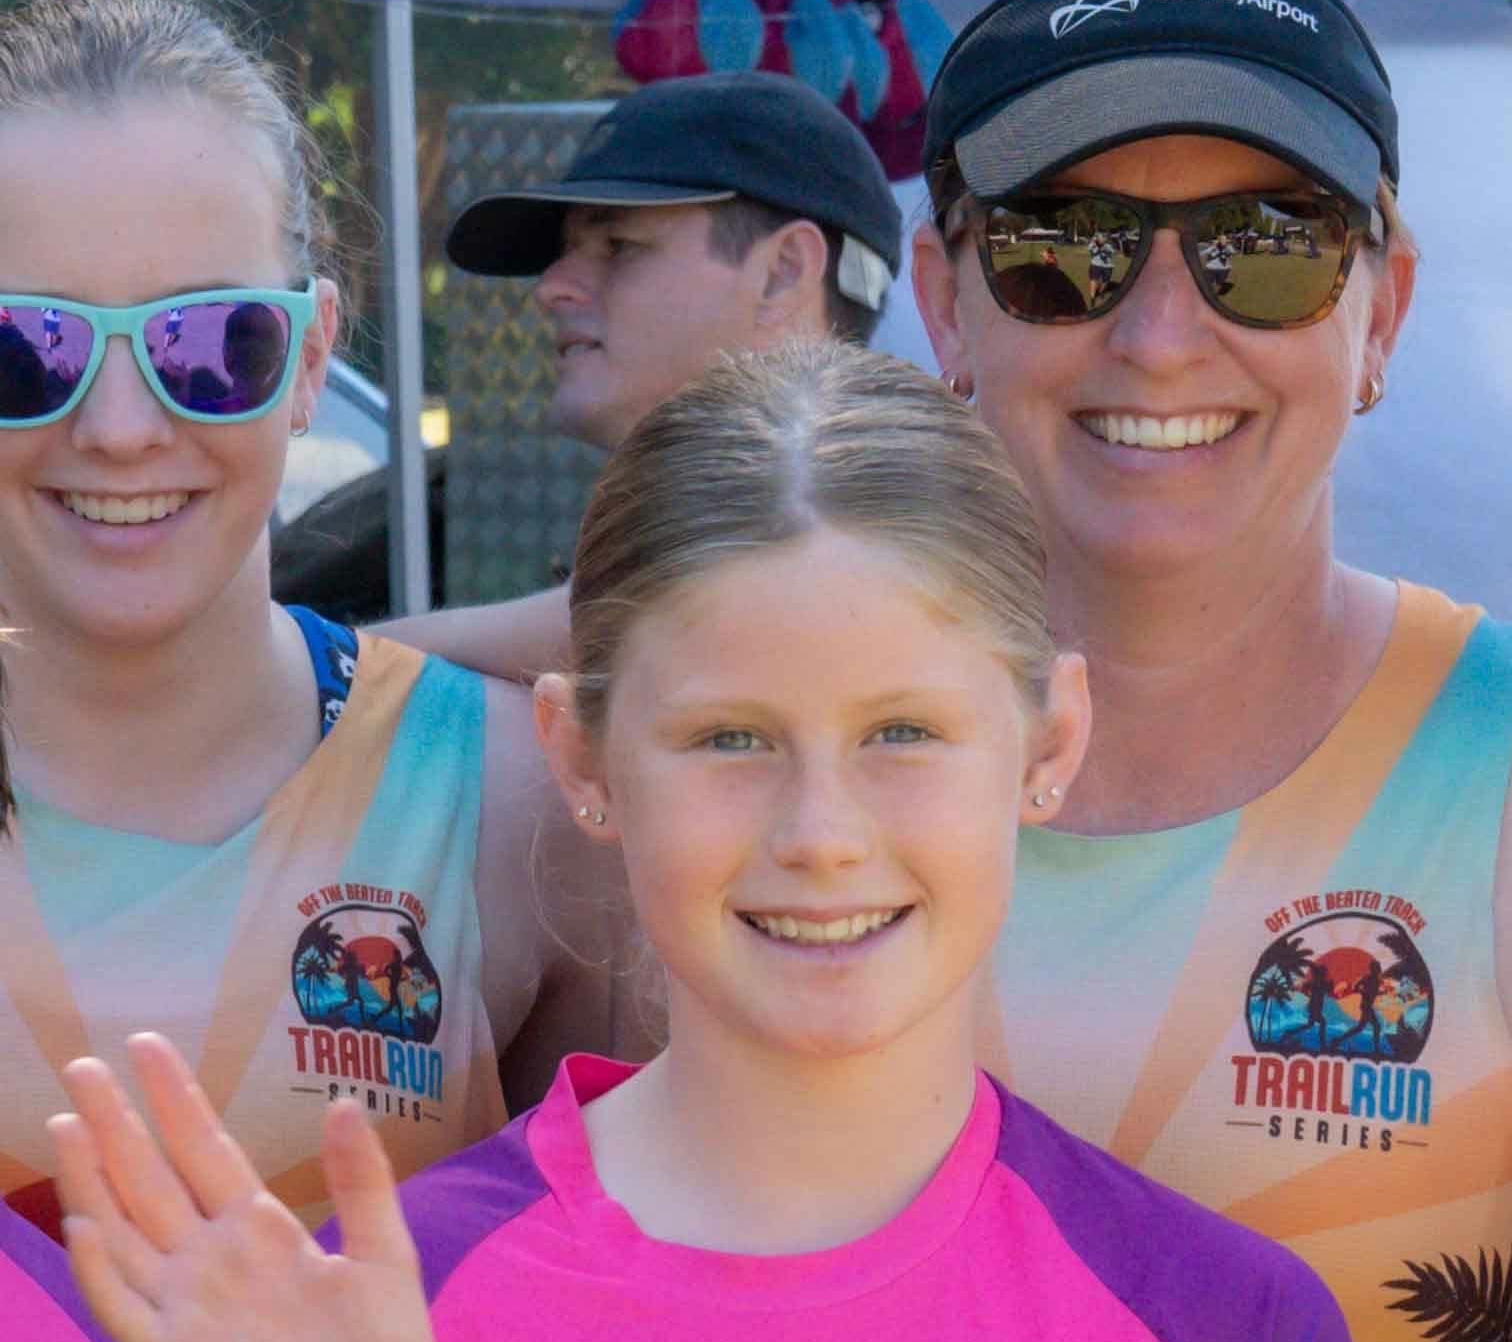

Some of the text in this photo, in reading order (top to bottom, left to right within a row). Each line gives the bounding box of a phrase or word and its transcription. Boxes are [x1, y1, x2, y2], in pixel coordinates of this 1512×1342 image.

[1292, 895, 1323, 917] THE
[1325, 889, 1381, 911] BEATEN
[288, 1026, 444, 1103] TRAILRUN
[1231, 1055, 1432, 1127] TRAILRUN
[1268, 1115, 1394, 1152] SERIES
